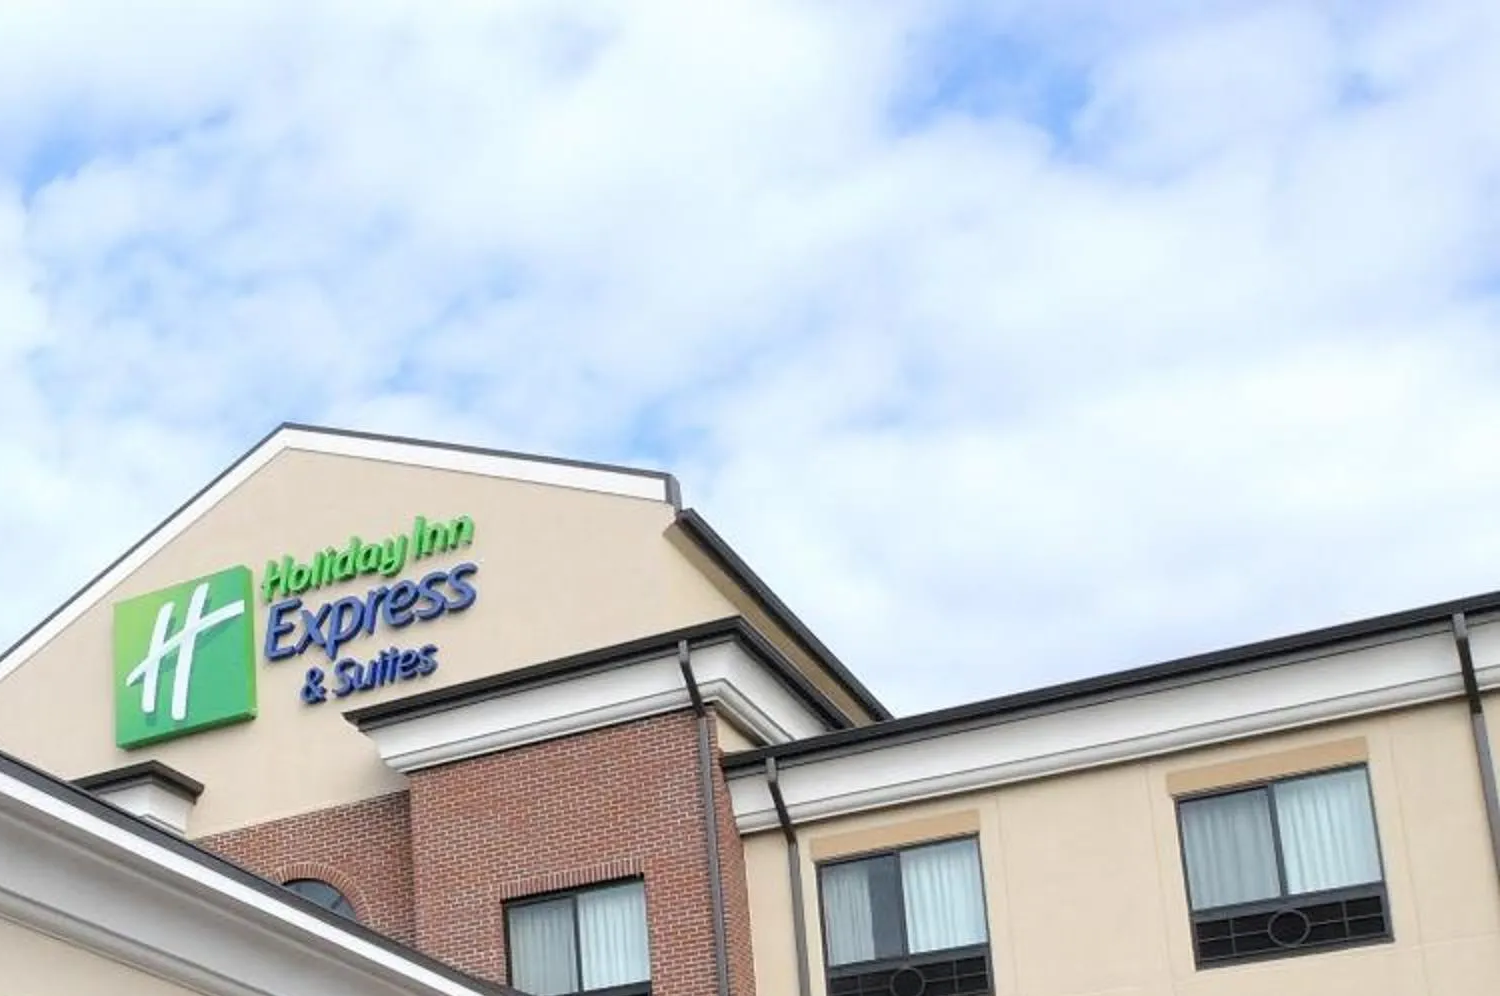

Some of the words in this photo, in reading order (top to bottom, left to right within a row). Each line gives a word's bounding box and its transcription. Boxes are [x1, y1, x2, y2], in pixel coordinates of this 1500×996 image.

[262, 535, 408, 602] Holiday
[412, 514, 475, 560] Inn
[264, 562, 478, 662] Express
[301, 667, 327, 704] &
[332, 644, 439, 697] Suites
